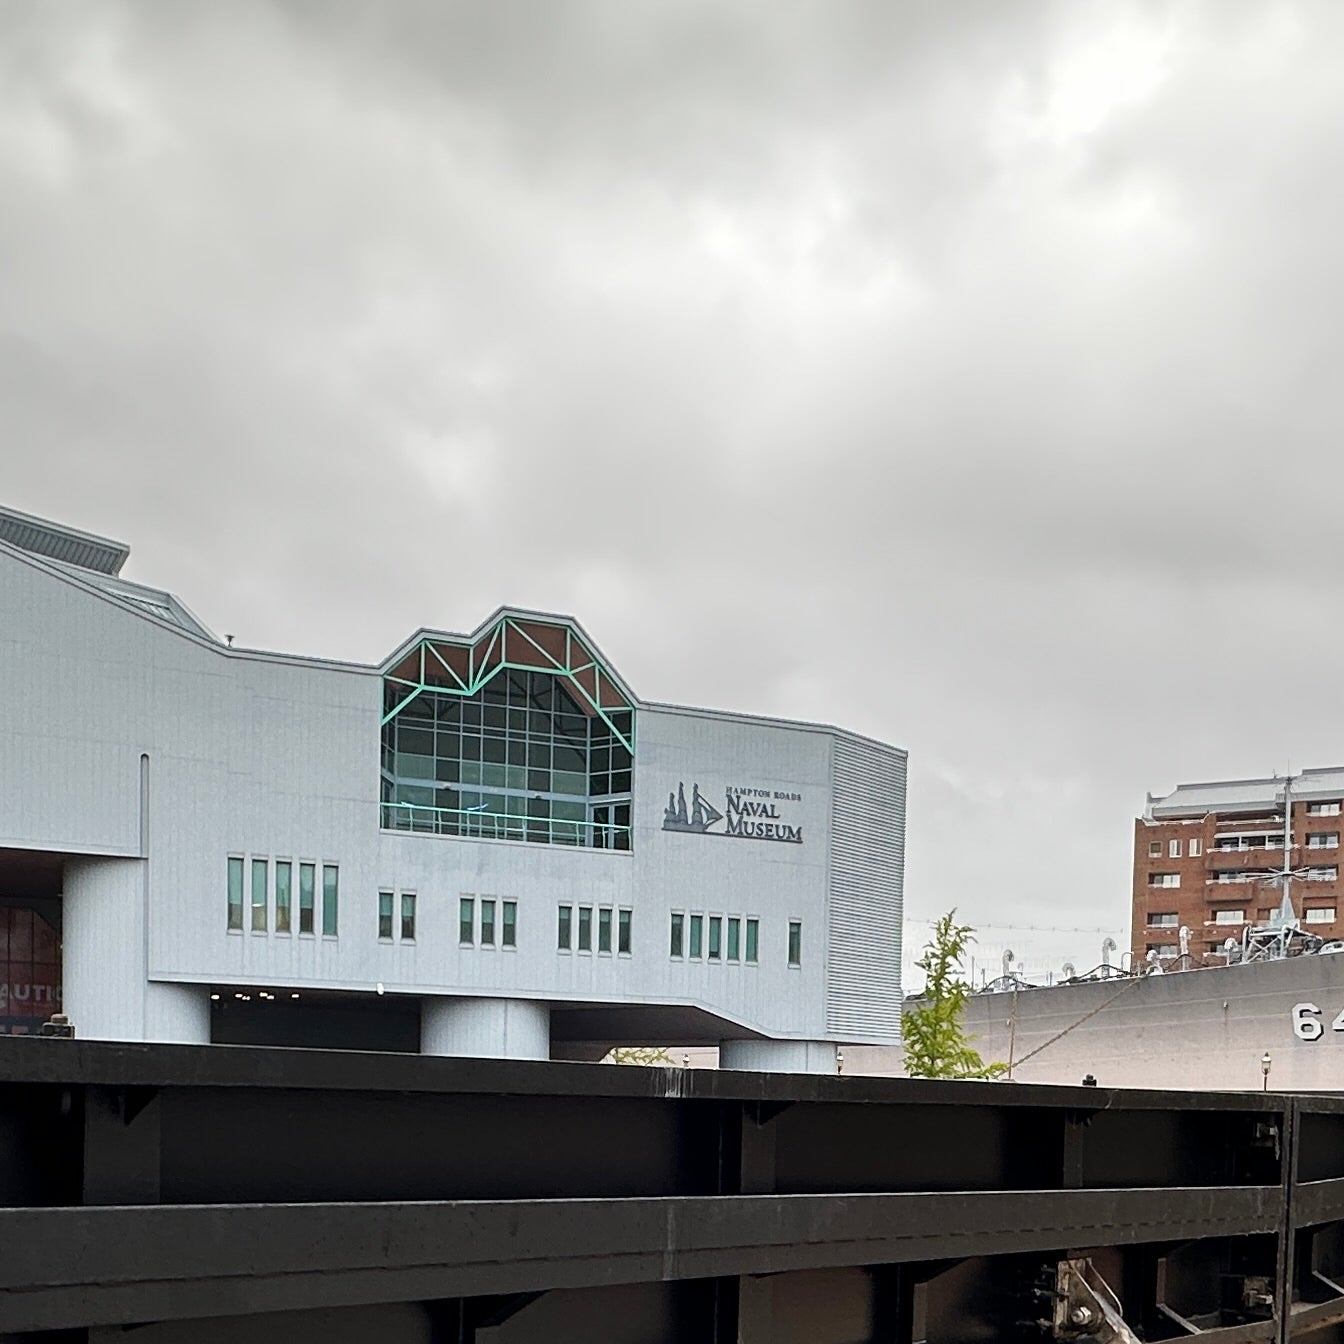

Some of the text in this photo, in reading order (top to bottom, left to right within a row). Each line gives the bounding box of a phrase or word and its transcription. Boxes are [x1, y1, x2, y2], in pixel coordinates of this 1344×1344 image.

[726, 786, 802, 801] HAMPTON ROADS
[725, 794, 781, 819] NAVAL
[724, 813, 803, 840] MUSEUM
